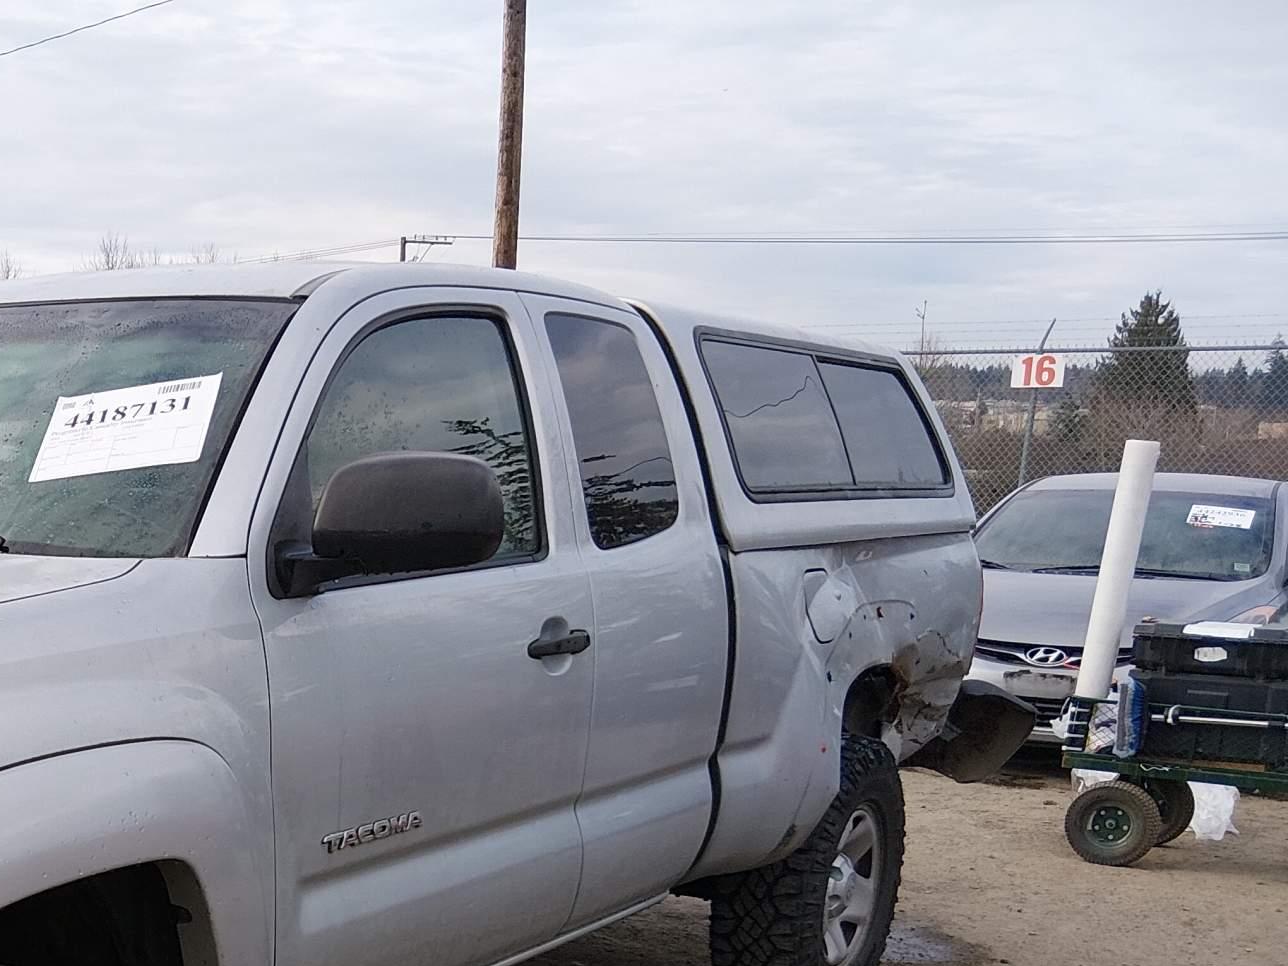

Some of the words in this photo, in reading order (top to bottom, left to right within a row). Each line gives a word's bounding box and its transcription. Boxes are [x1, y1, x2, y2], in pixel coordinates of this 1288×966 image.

[1022, 355, 1056, 386] 16
[64, 395, 192, 429] 44187131
[321, 811, 422, 853] TACOMA
